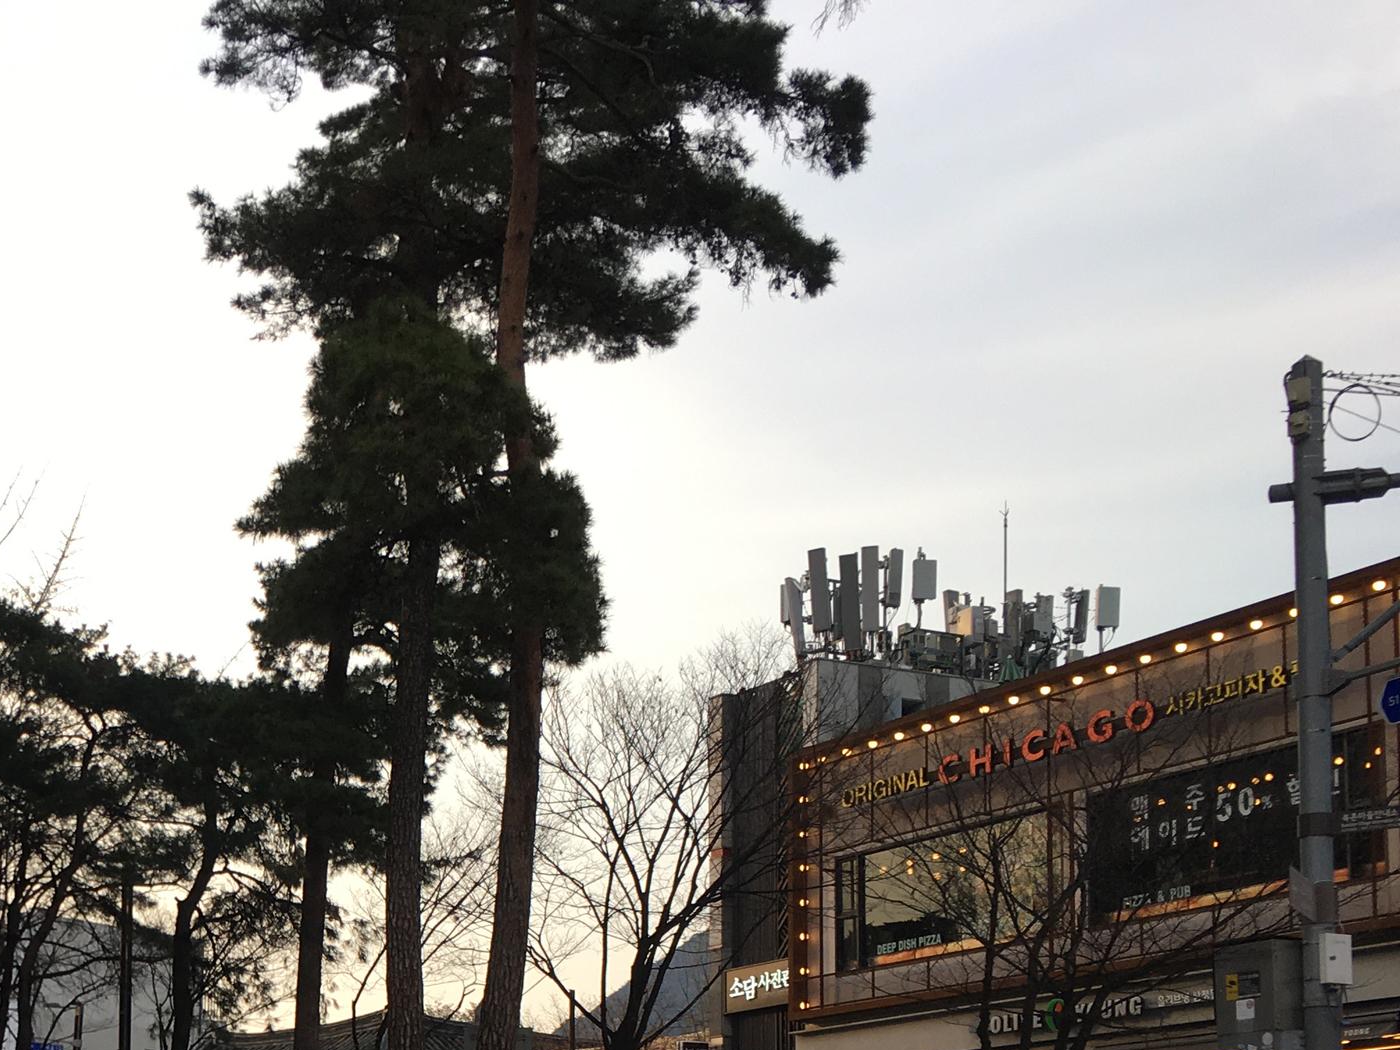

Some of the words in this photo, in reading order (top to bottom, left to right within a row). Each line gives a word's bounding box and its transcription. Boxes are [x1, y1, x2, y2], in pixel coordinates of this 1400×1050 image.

[1165, 671, 1267, 716] 시카고피자
[1269, 664, 1288, 689] &
[841, 766, 931, 809] ORIGINAL
[937, 699, 1156, 785] CHICAGO
[1170, 884, 1192, 899] PUB
[876, 941, 897, 955] DEEP
[898, 937, 918, 951] DISH
[919, 933, 942, 948] PIZZA
[989, 1011, 1043, 1034] OLIE
